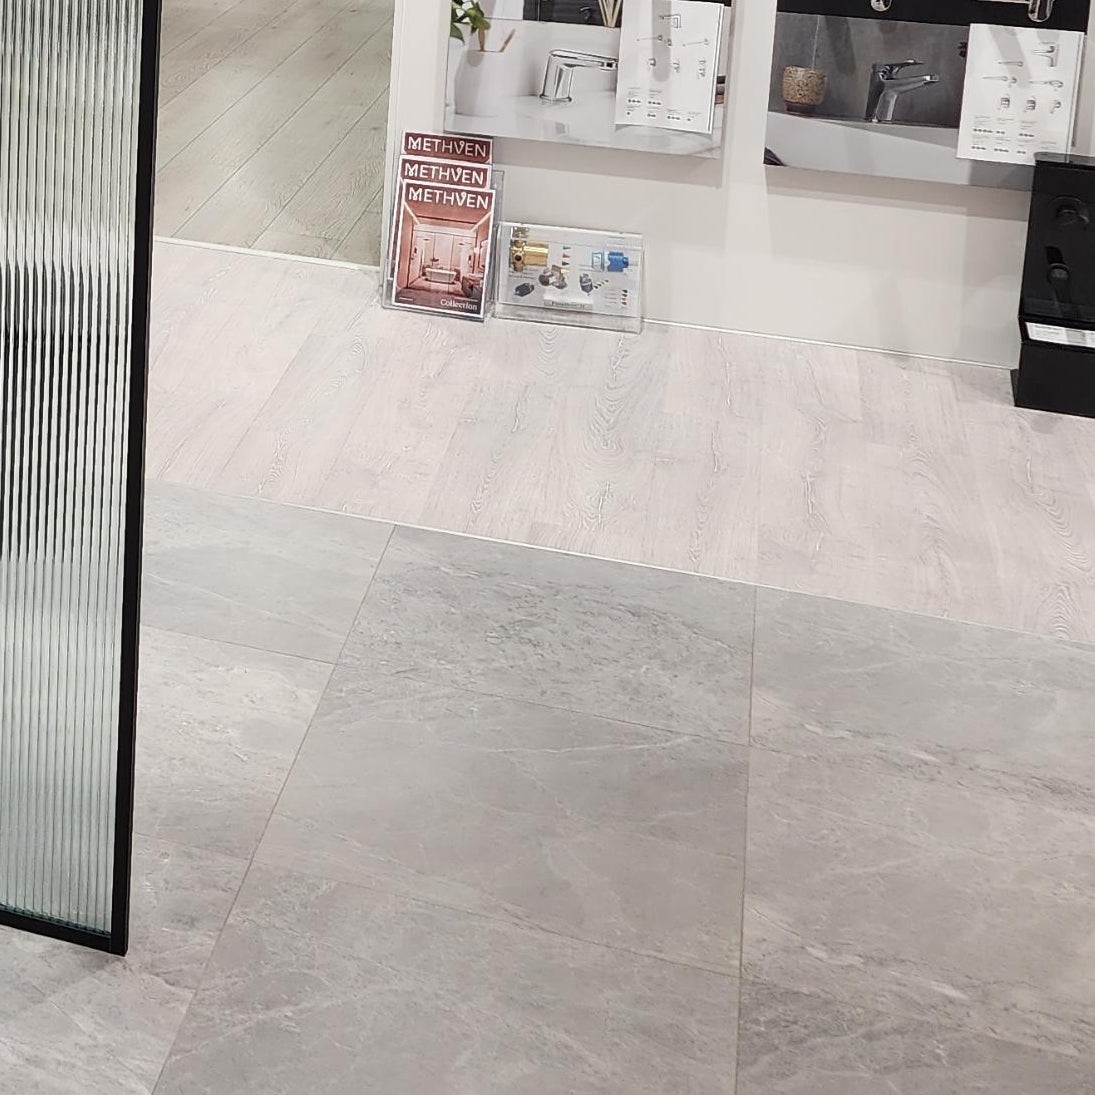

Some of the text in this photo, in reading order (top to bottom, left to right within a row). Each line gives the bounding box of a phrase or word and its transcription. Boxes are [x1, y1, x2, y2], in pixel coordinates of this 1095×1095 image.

[407, 136, 486, 158] METHVEN
[404, 162, 484, 185] METHVEN
[408, 187, 489, 210] METHVEN
[440, 298, 478, 311] Collection
